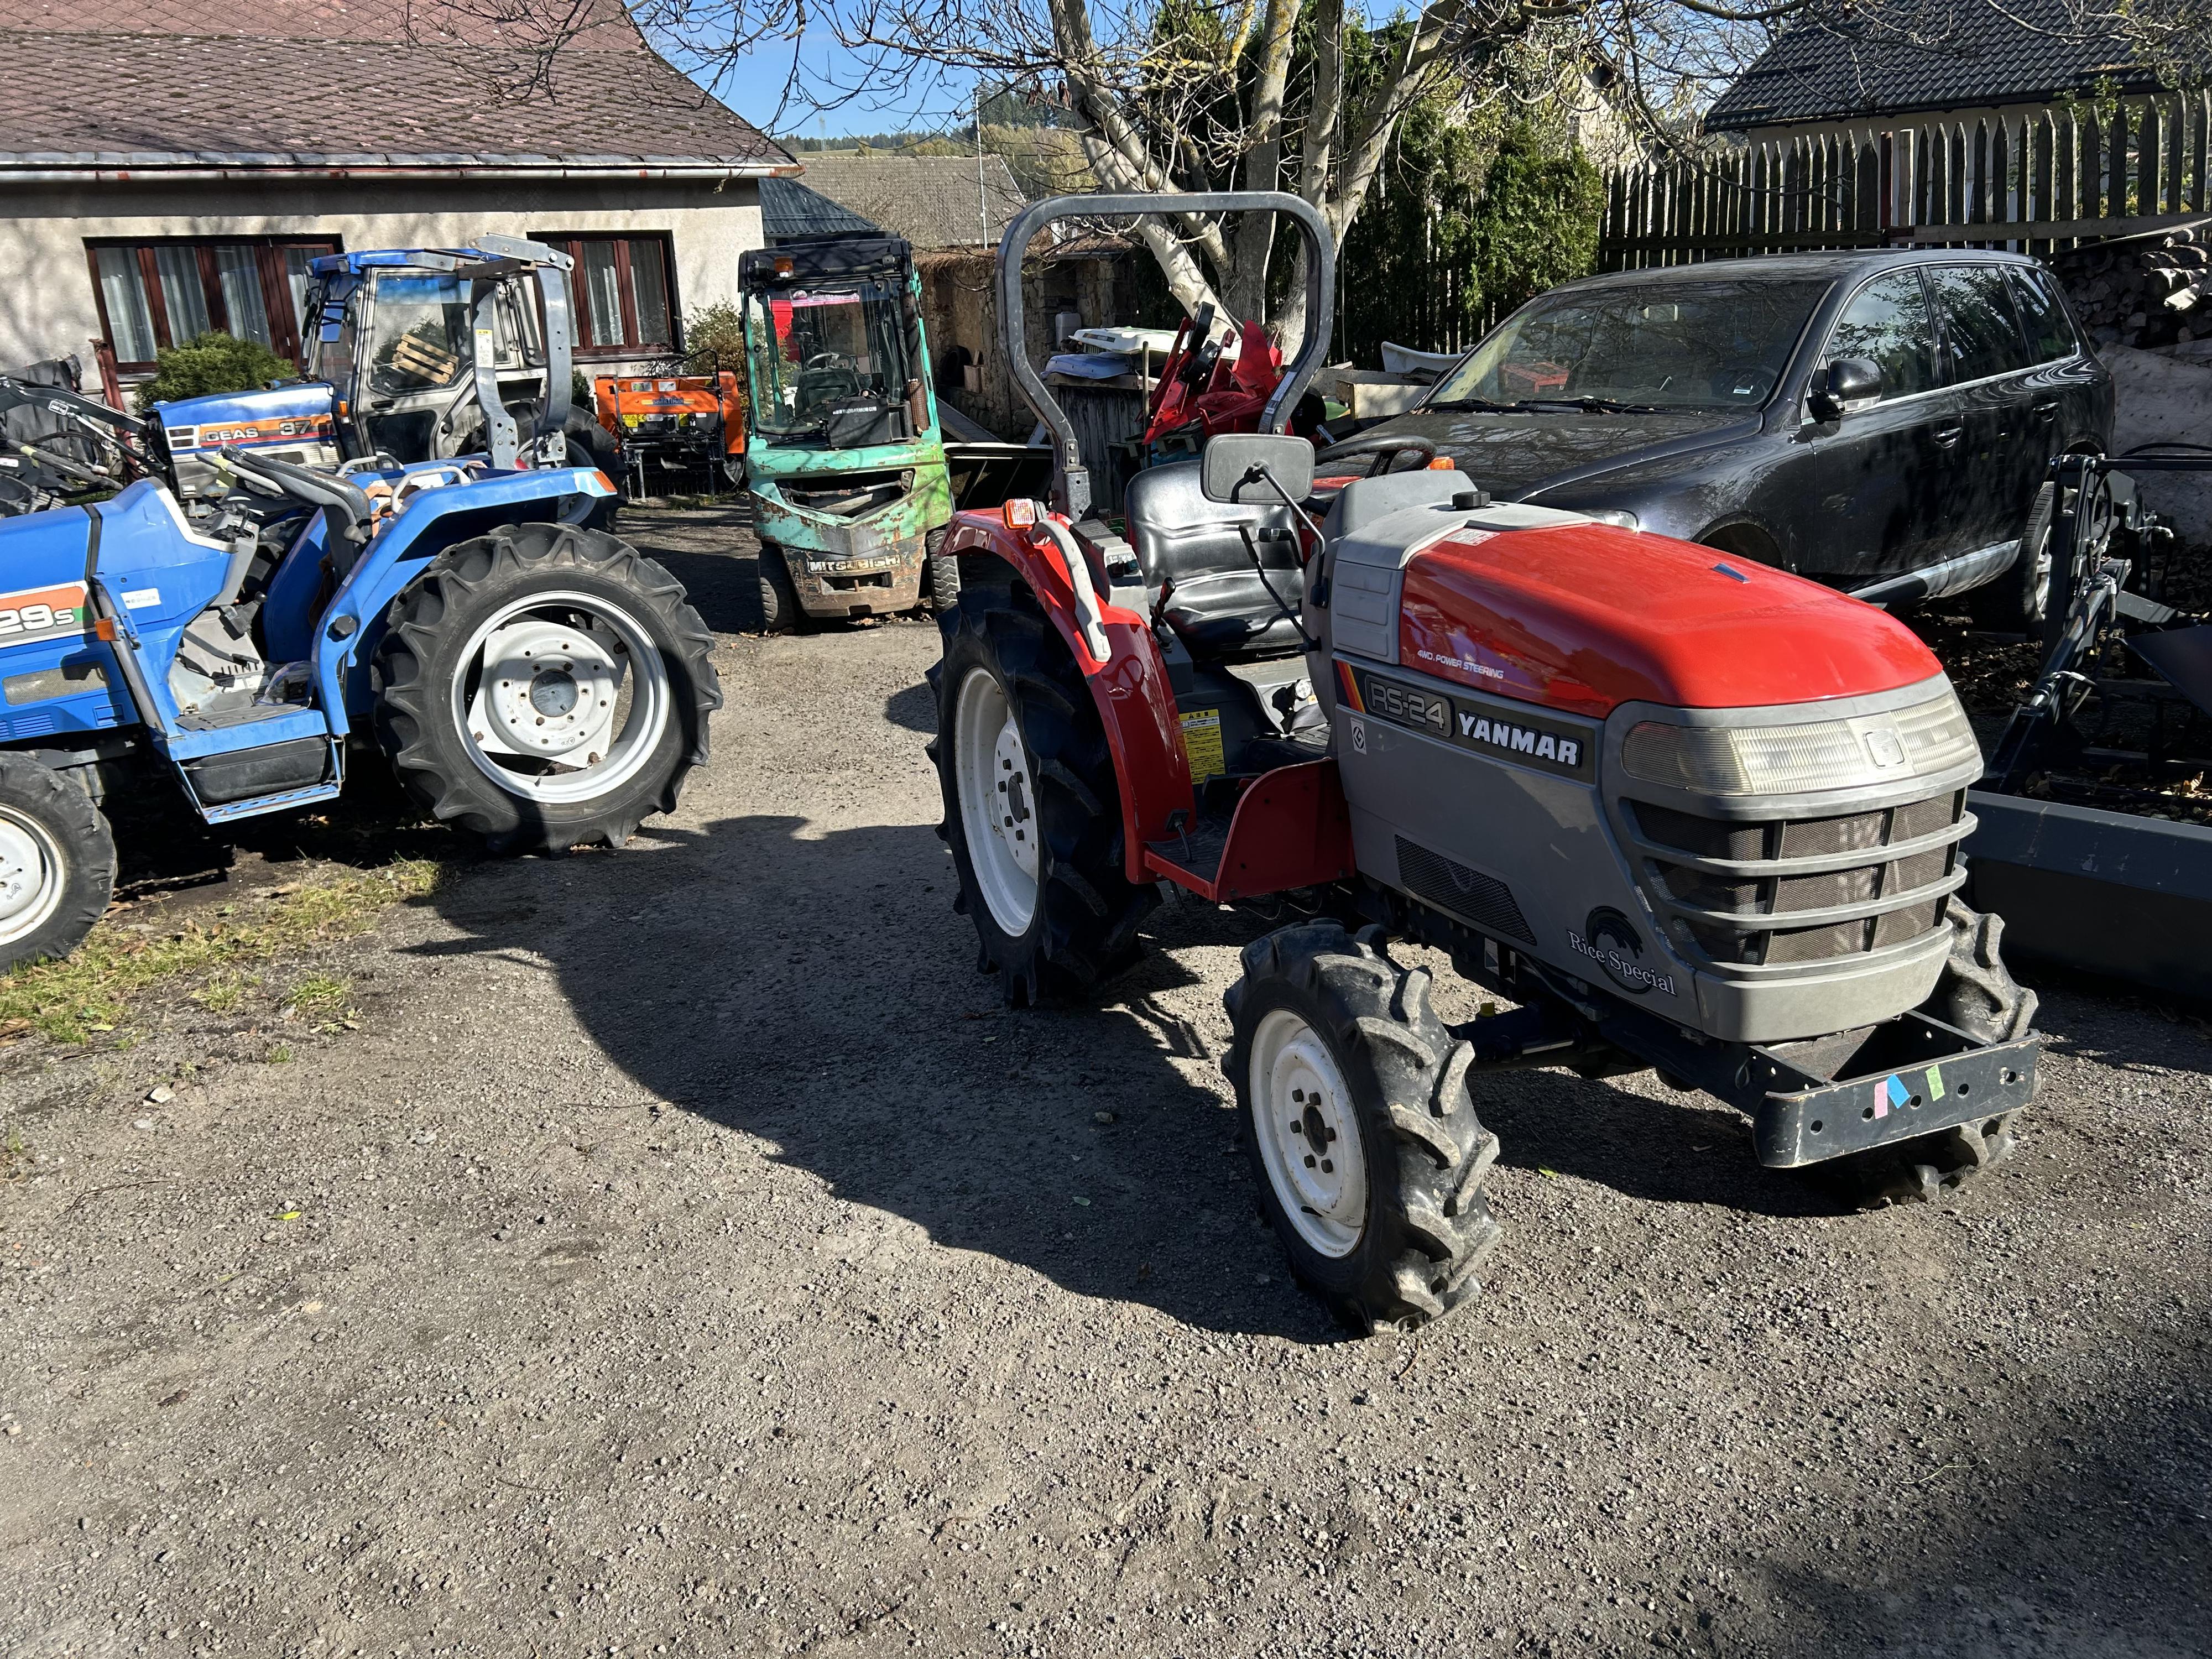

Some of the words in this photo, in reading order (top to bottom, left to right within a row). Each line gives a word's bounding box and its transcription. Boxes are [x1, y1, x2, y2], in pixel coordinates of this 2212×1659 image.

[205, 427, 259, 442] GEAS
[279, 420, 311, 436] 37
[810, 554, 900, 572] MITSUBISHI
[1463, 661, 1504, 680] STEERING
[1370, 682, 1444, 729] RS-24
[1459, 712, 1578, 766] YANMAR
[1567, 930, 1606, 963] Rice
[1608, 950, 1678, 996] Special
